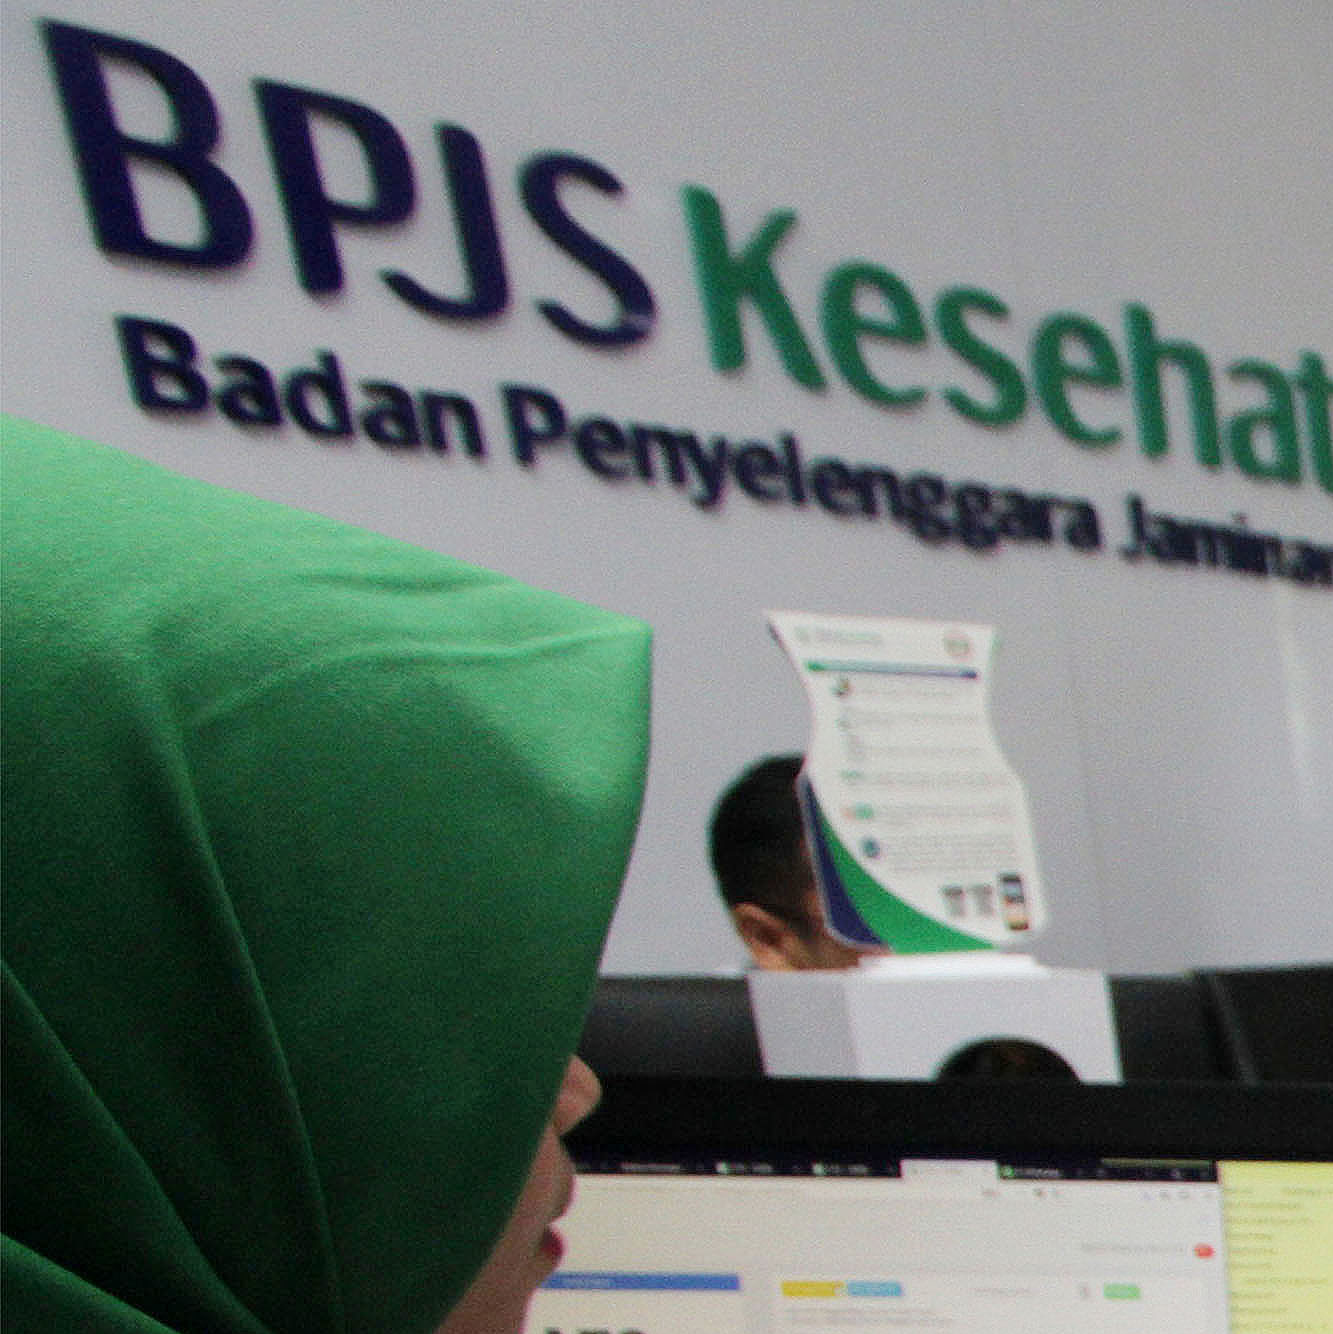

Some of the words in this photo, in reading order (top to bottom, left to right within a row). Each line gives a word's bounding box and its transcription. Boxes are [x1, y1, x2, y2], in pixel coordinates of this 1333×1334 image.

[38, 18, 658, 350] BPJS
[115, 315, 485, 462] Badan
[502, 380, 1102, 556] Penyelenggara
